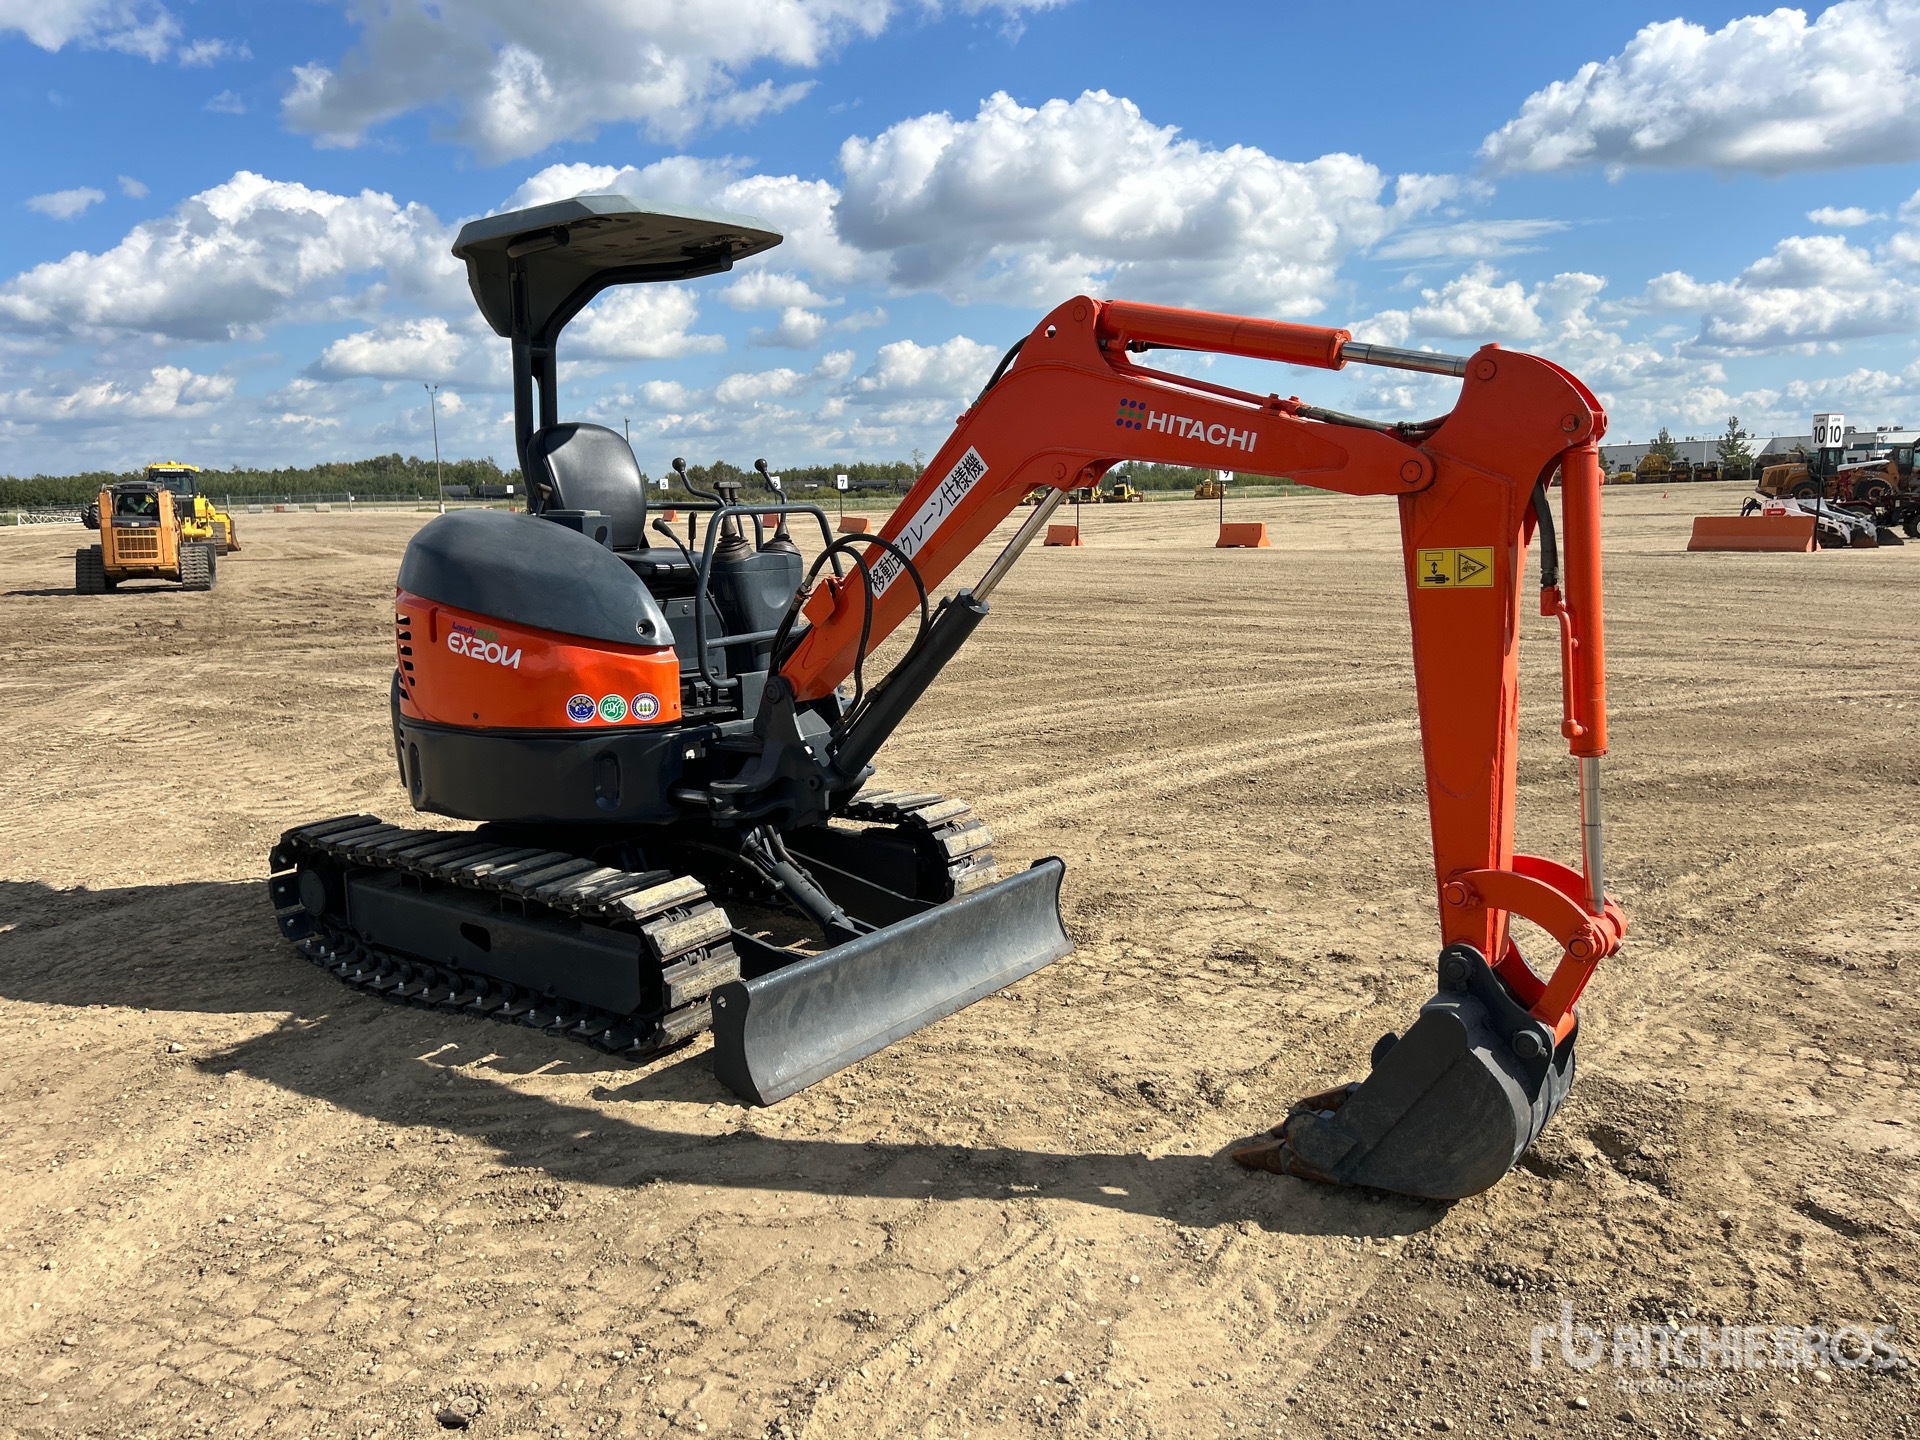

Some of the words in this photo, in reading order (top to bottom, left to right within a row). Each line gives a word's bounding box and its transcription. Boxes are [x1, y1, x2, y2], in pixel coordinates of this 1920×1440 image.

[1146, 410, 1258, 453] HITACHI
[1813, 425, 1826, 443] 10
[1829, 425, 1842, 443] 10
[839, 479, 845, 487] 7
